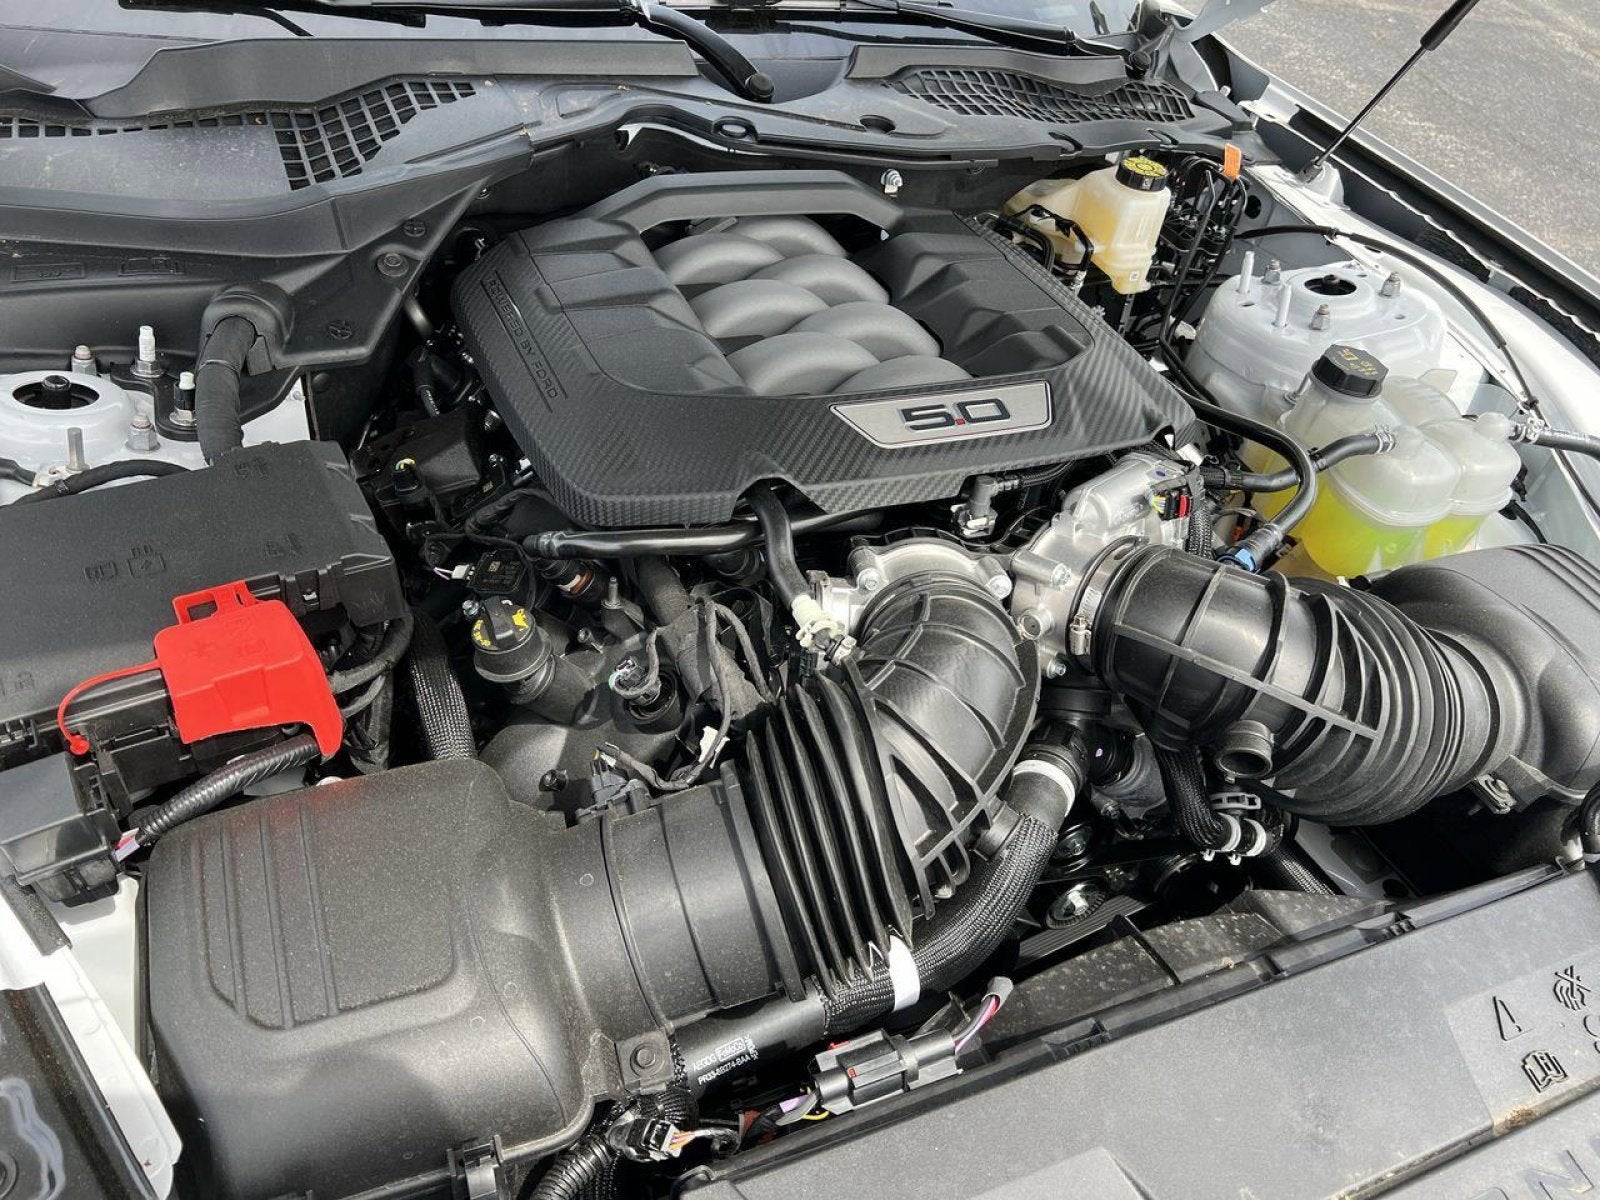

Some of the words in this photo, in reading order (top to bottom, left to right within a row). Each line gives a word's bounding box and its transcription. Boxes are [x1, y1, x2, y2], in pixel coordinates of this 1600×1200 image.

[488, 278, 522, 337] POWERED
[520, 339, 536, 356] BY
[532, 361, 558, 399] FORD
[900, 398, 1011, 431] 5.0
